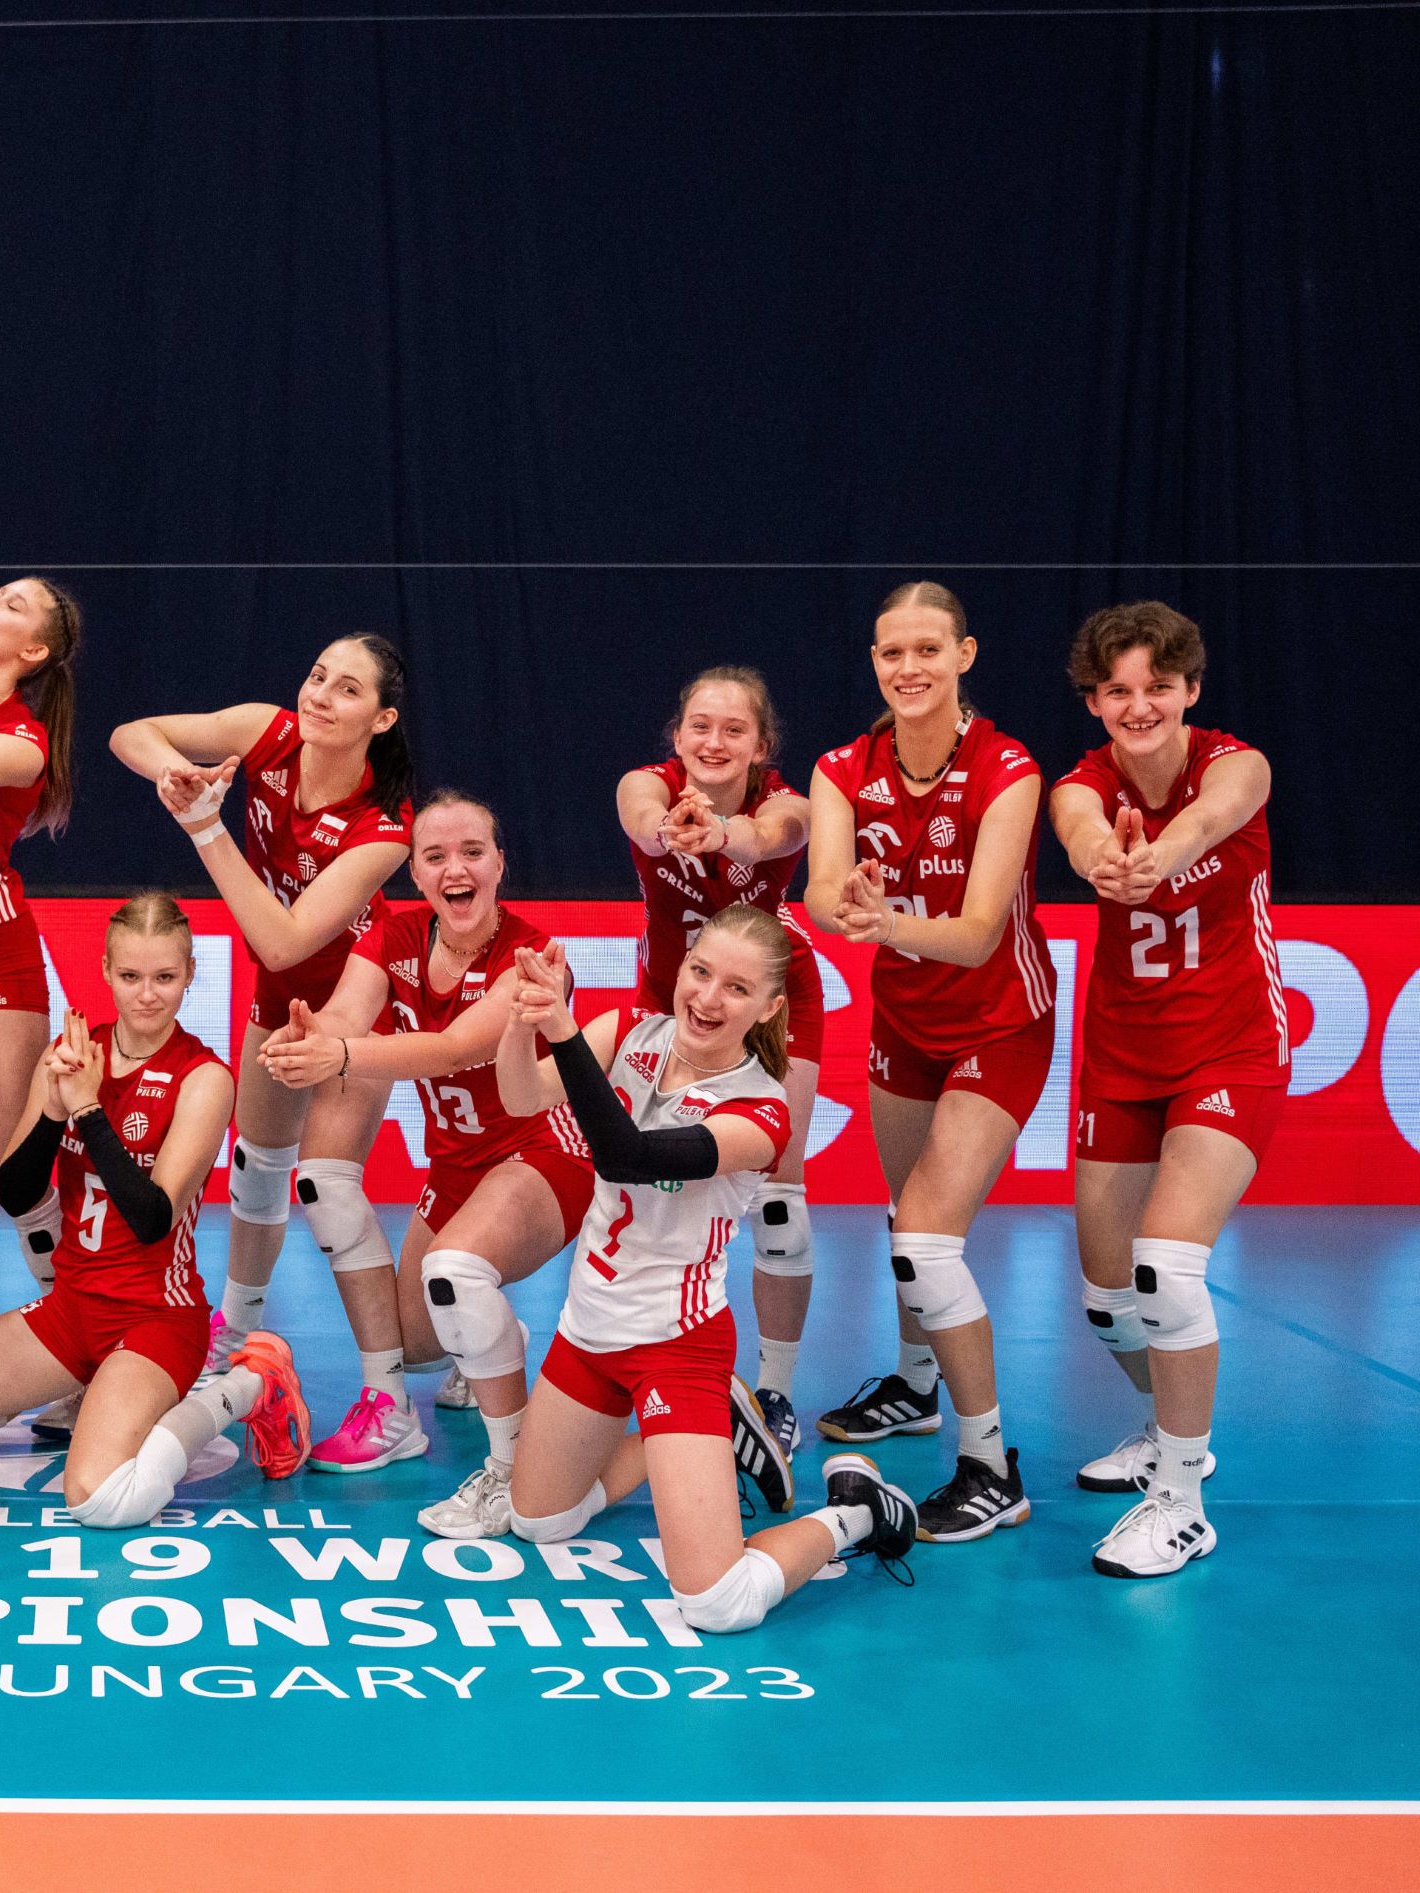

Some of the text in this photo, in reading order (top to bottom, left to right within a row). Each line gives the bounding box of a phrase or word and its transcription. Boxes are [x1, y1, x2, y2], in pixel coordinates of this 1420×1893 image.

[261, 770, 288, 797] adidas
[859, 789, 896, 806] adidas
[918, 854, 965, 879] plus
[1169, 855, 1222, 894] plus
[657, 867, 703, 903] ORLEN
[1130, 906, 1199, 978] 21
[389, 962, 421, 988] adidas
[624, 1052, 656, 1084] adidas
[419, 1078, 486, 1135] 13
[754, 1109, 780, 1129] ORLEN
[1196, 1101, 1236, 1117] adidas
[79, 1172, 108, 1252] 5
[267, 1537, 848, 1583] WOR
[531, 1665, 816, 1701] 2023
